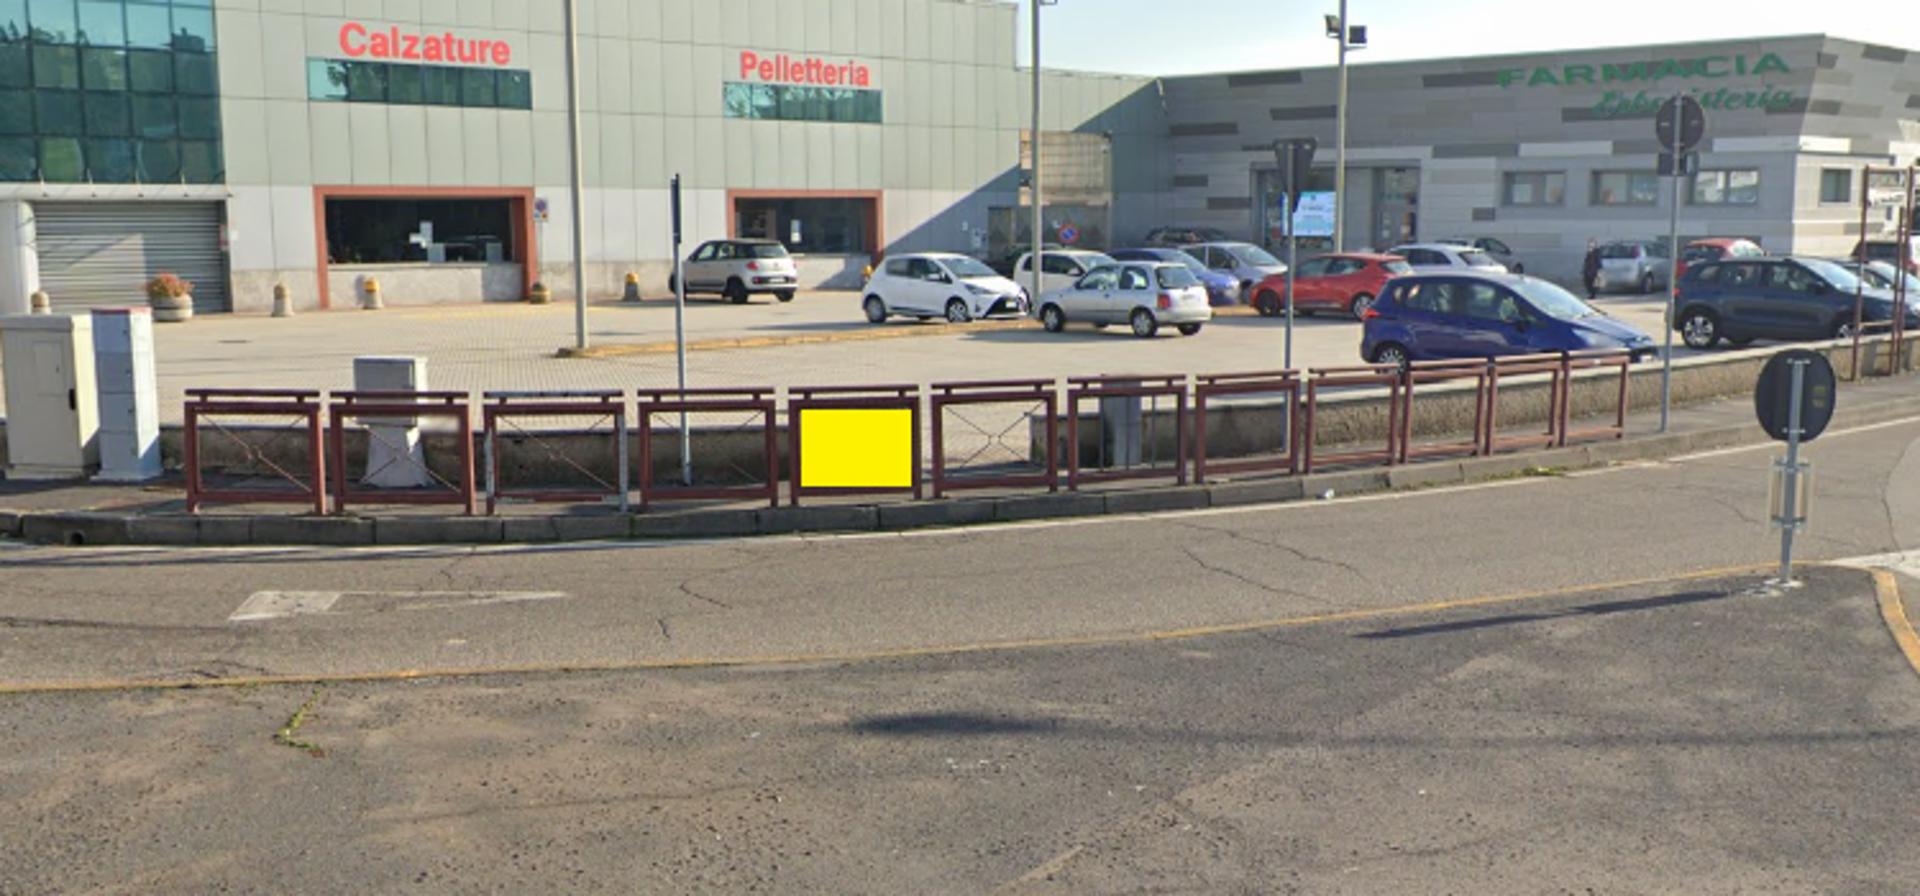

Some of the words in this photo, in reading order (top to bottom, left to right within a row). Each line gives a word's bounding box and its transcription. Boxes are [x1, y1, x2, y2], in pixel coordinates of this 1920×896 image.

[339, 22, 511, 65] Calzature
[740, 50, 869, 87] Pelletteria
[1496, 52, 1791, 88] FARMACIA
